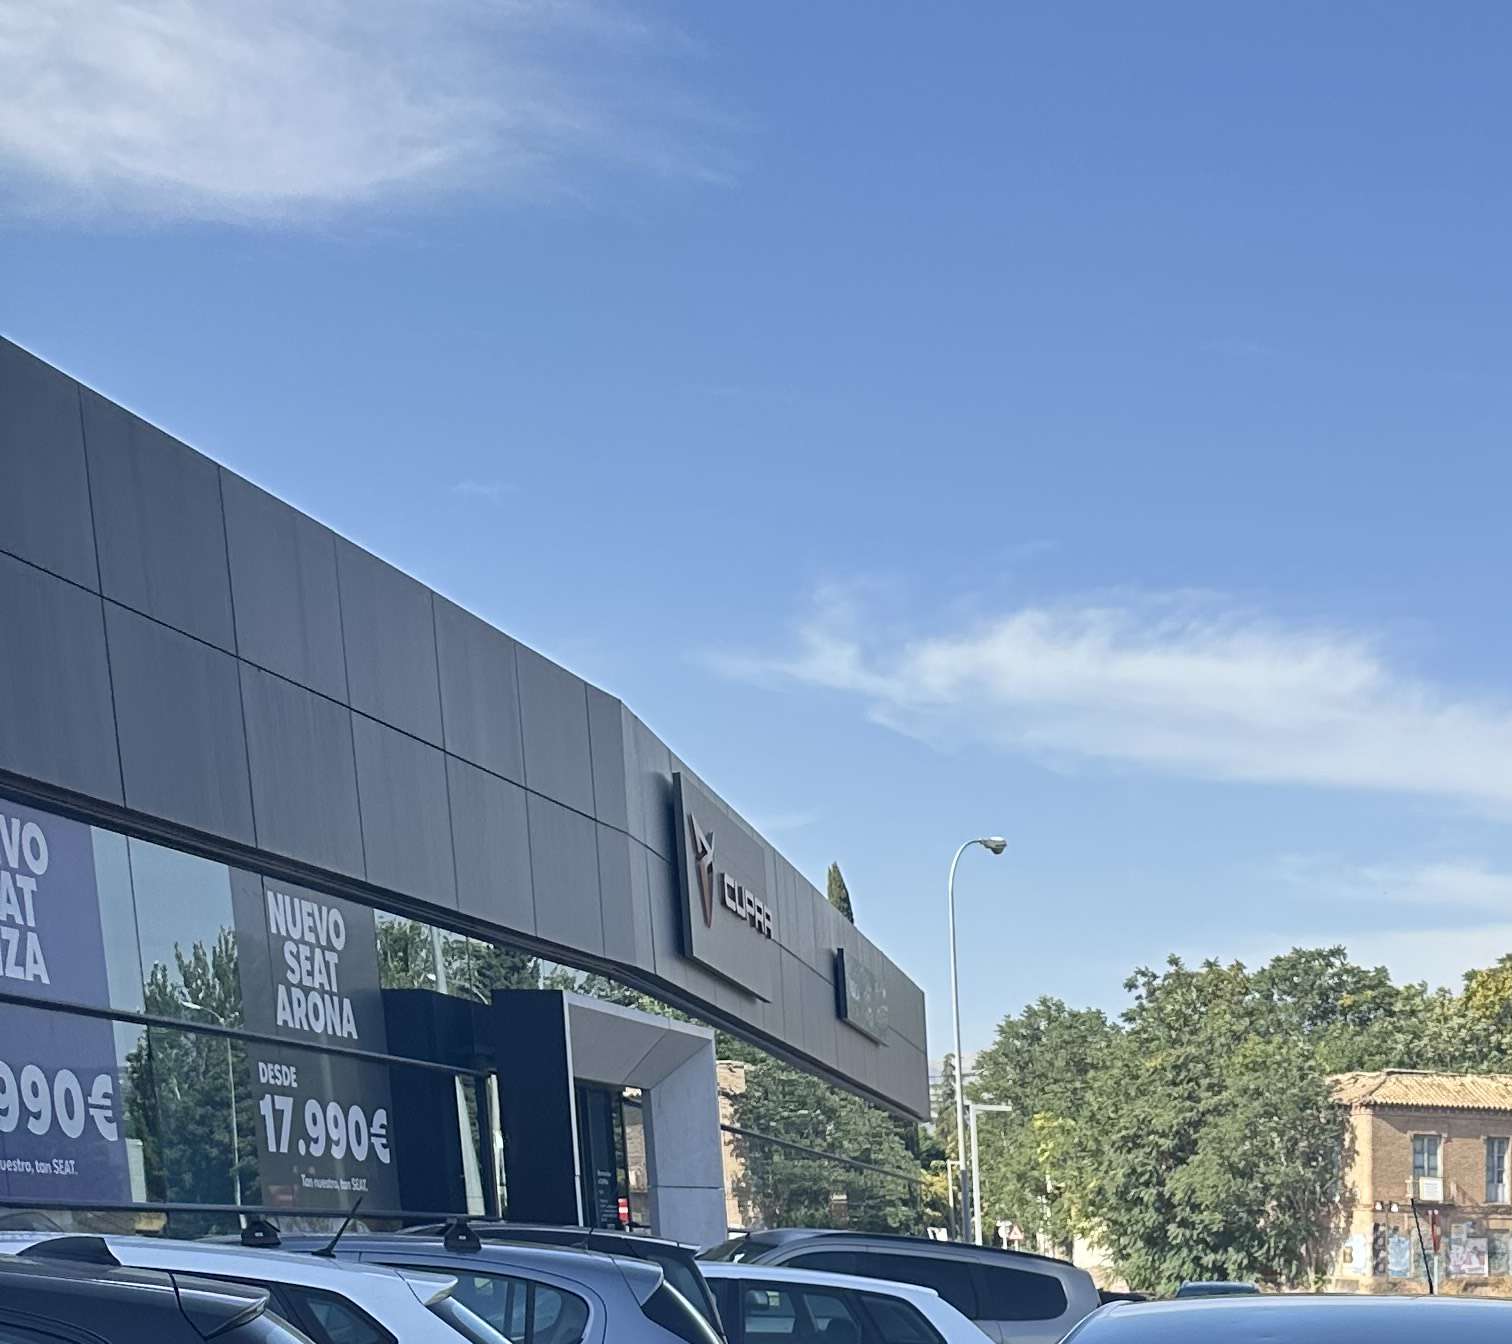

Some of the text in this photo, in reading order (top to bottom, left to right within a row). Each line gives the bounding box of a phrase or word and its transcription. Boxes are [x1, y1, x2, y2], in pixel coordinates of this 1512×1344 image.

[267, 891, 346, 951] NUEVO
[721, 872, 774, 940] CUPRA
[0, 925, 50, 985] ZA
[283, 940, 338, 993] SEAT
[276, 983, 358, 1040] ARONA
[258, 1061, 298, 1088] DESDE
[259, 1094, 391, 1164] 17.990€
[35, 1160, 52, 1173] tan
